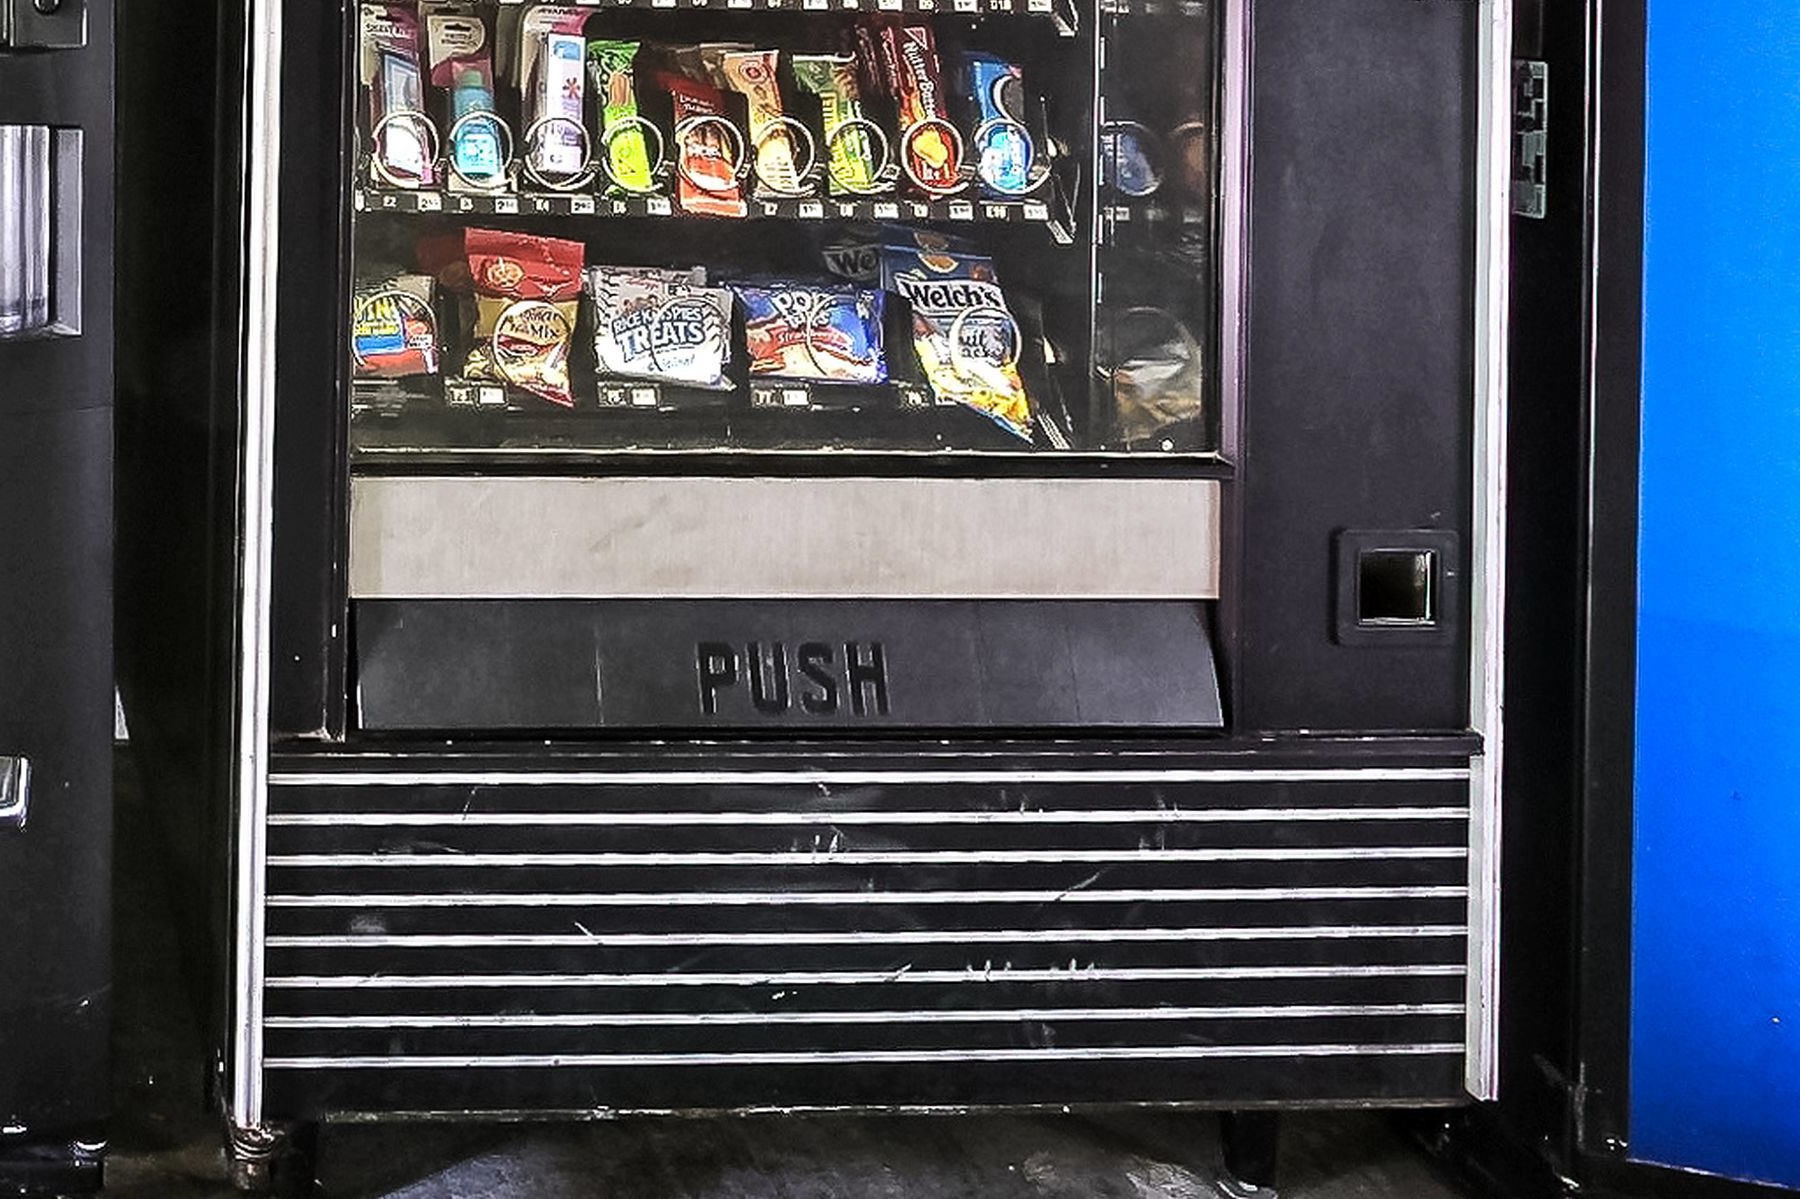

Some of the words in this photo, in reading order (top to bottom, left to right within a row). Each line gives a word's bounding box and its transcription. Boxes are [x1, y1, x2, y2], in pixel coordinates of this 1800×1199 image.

[906, 284, 1004, 311] Welch's
[612, 309, 643, 336] RICE
[642, 305, 703, 326] KSPIES
[615, 320, 705, 363] TREATS
[695, 640, 891, 717] PUSH
